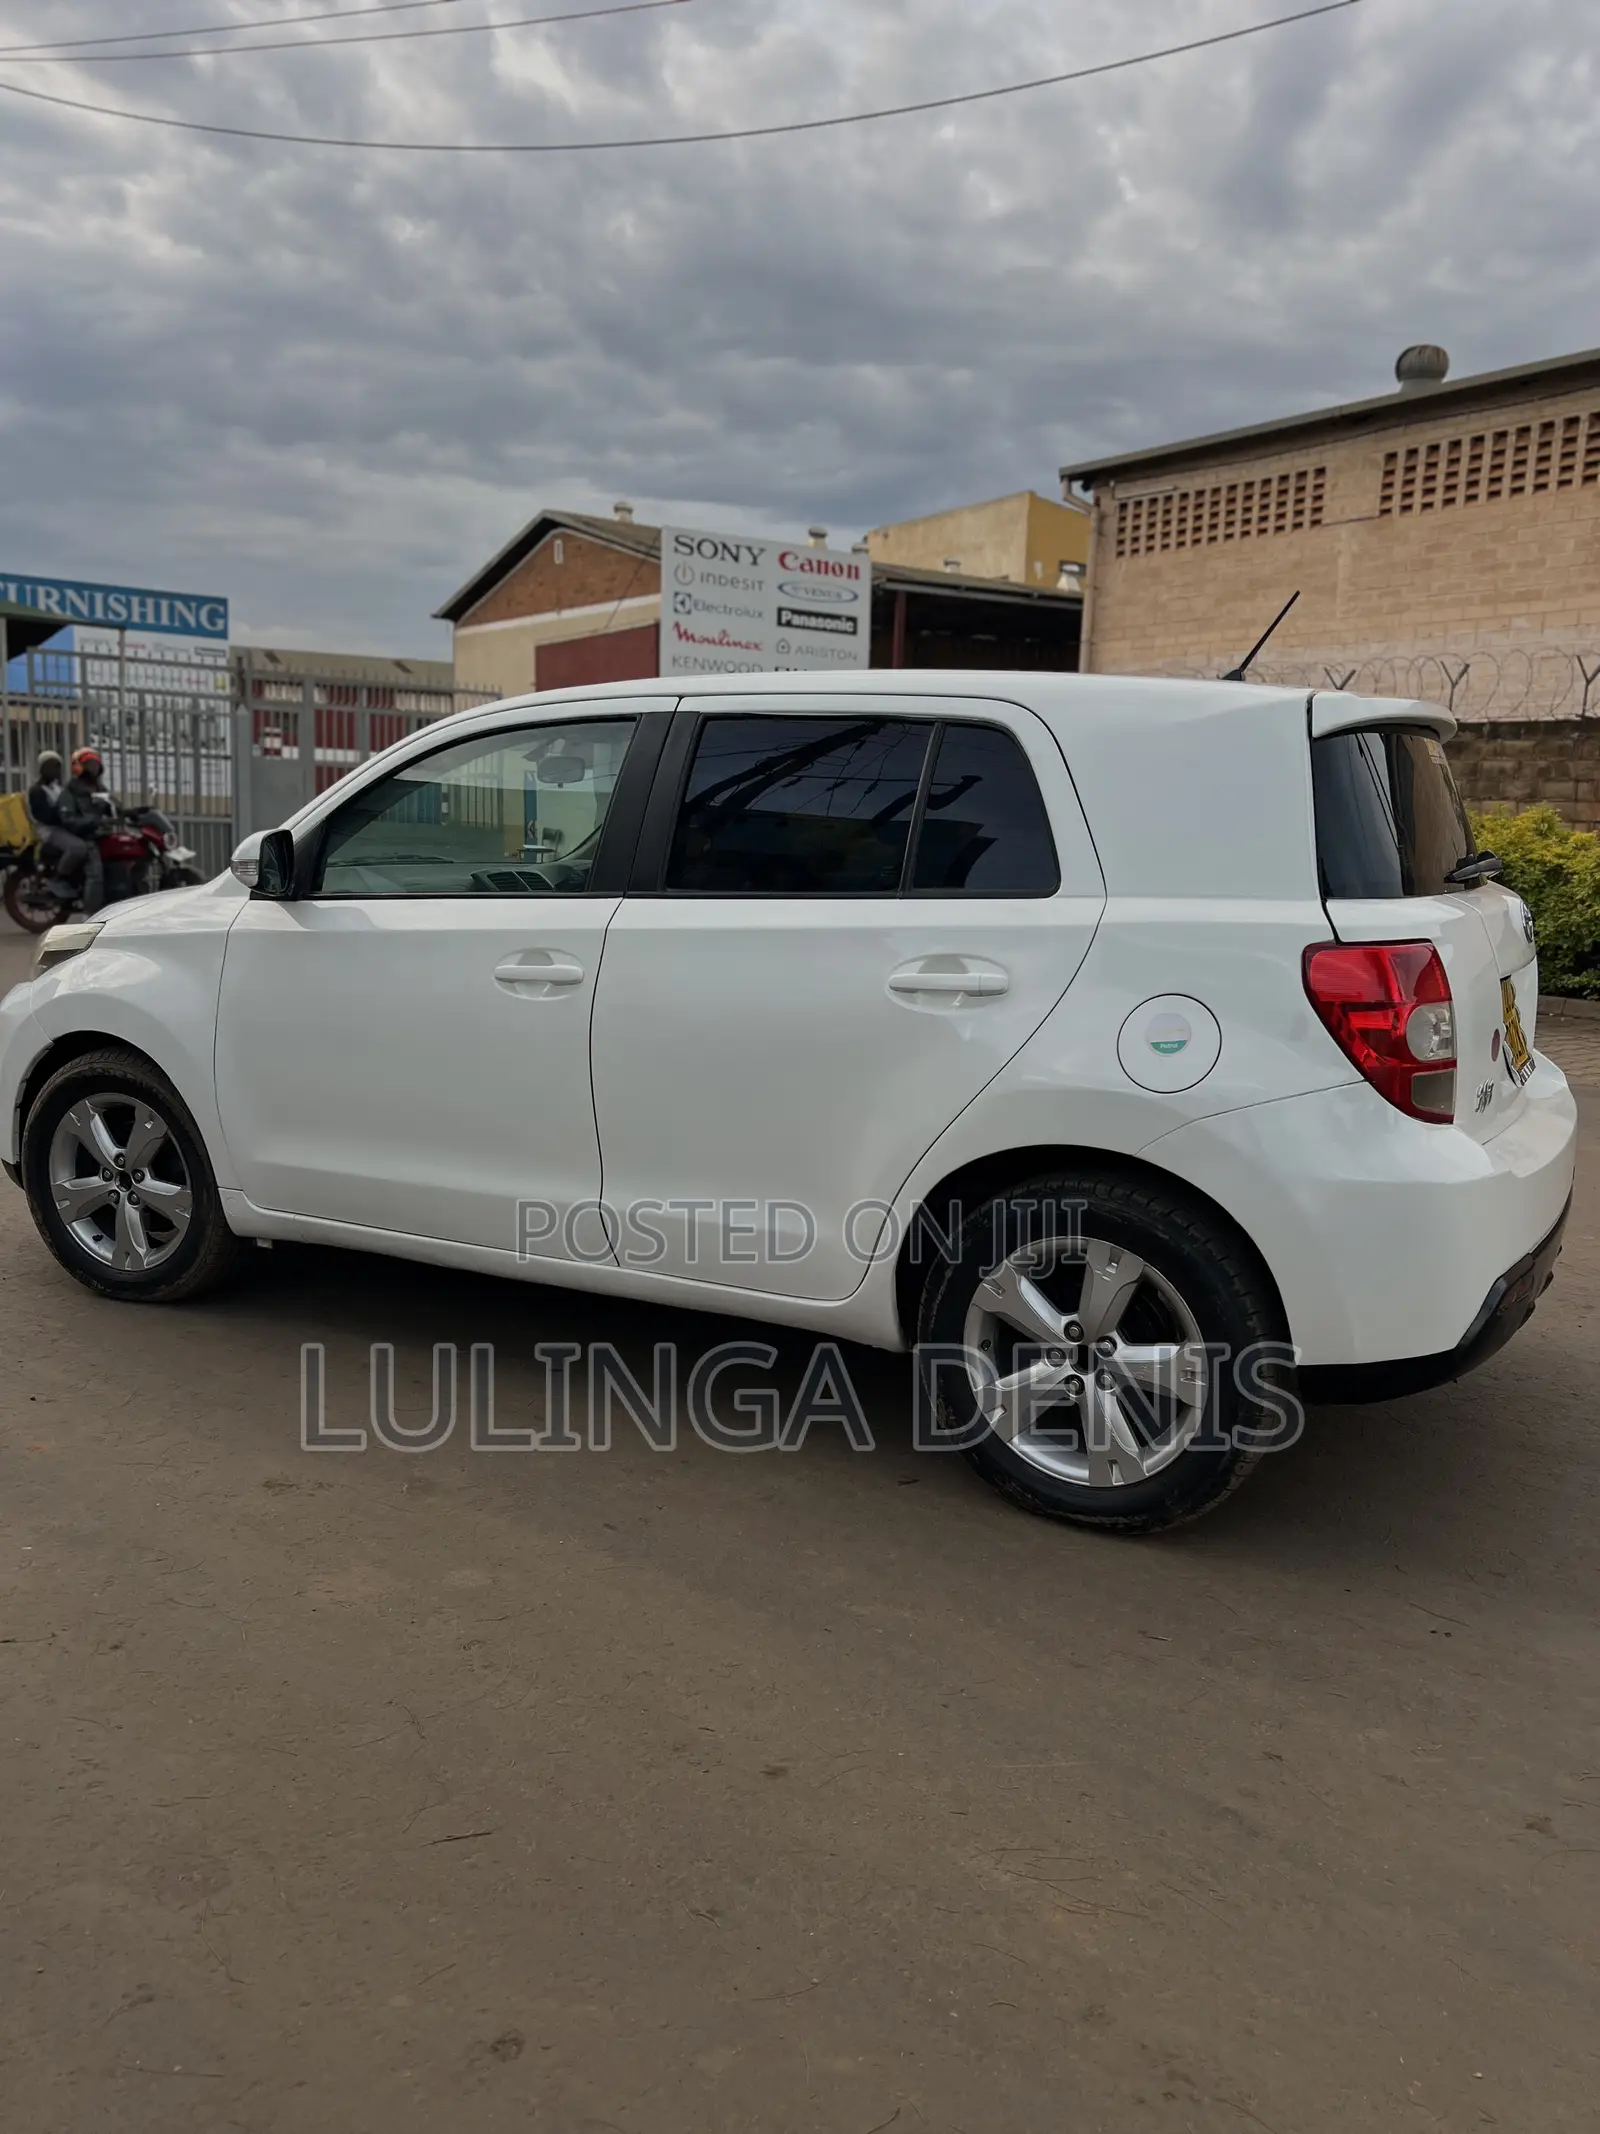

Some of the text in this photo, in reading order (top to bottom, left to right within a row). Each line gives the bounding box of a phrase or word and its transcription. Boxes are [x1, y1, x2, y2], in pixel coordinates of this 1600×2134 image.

[674, 534, 767, 566] SONY
[778, 551, 861, 580] Canon
[0, 581, 226, 631] URNISHING
[693, 599, 764, 620] Electrolux
[780, 609, 855, 633] Panasonic
[672, 621, 764, 652] Moulinex
[672, 655, 763, 673] KENWOOD
[795, 645, 858, 662] ARISTON
